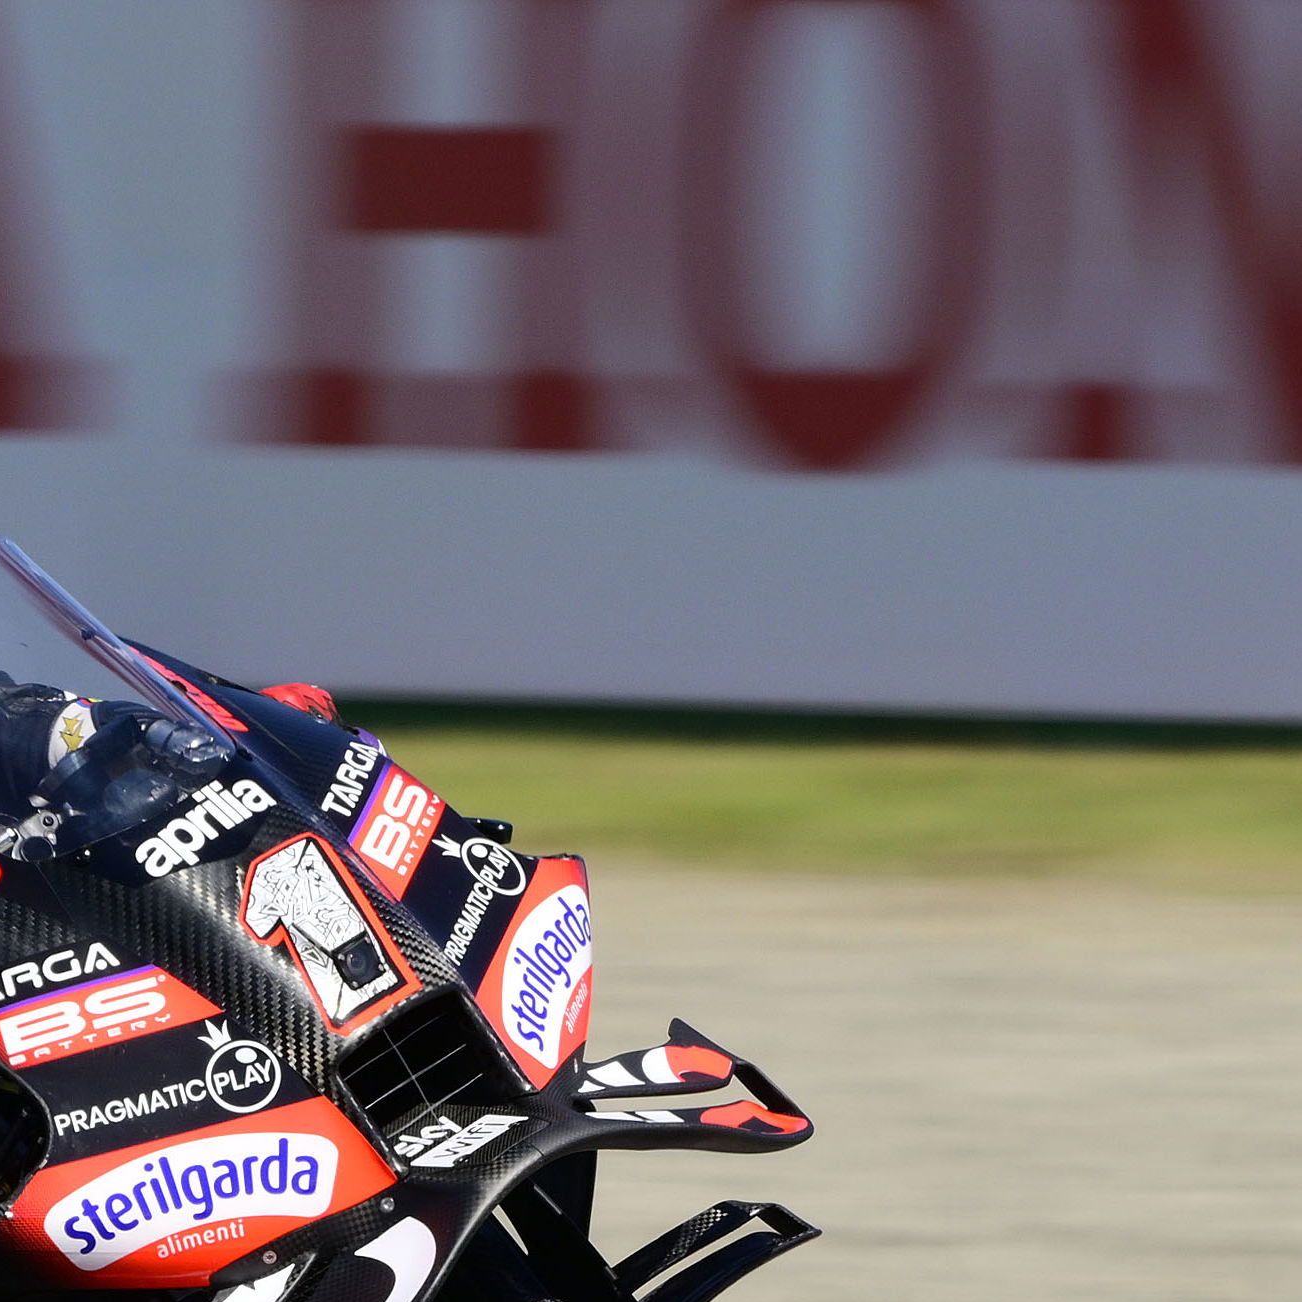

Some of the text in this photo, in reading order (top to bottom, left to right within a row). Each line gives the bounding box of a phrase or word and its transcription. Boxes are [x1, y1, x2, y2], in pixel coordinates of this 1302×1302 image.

[320, 741, 380, 817] TARGA
[359, 774, 428, 870] BS
[135, 778, 278, 879] aprilia
[397, 794, 440, 877] BATTERY
[239, 831, 423, 1037] 1
[442, 845, 511, 968] PRAGMATIC PLAY
[511, 896, 593, 1051] sterilgarda
[8, 1012, 172, 1067] BATTERY
[53, 1059, 272, 1137] PRAGMATIC PLAY
[63, 1137, 319, 1256] sterilgarda
[155, 1219, 246, 1260] alimenti
